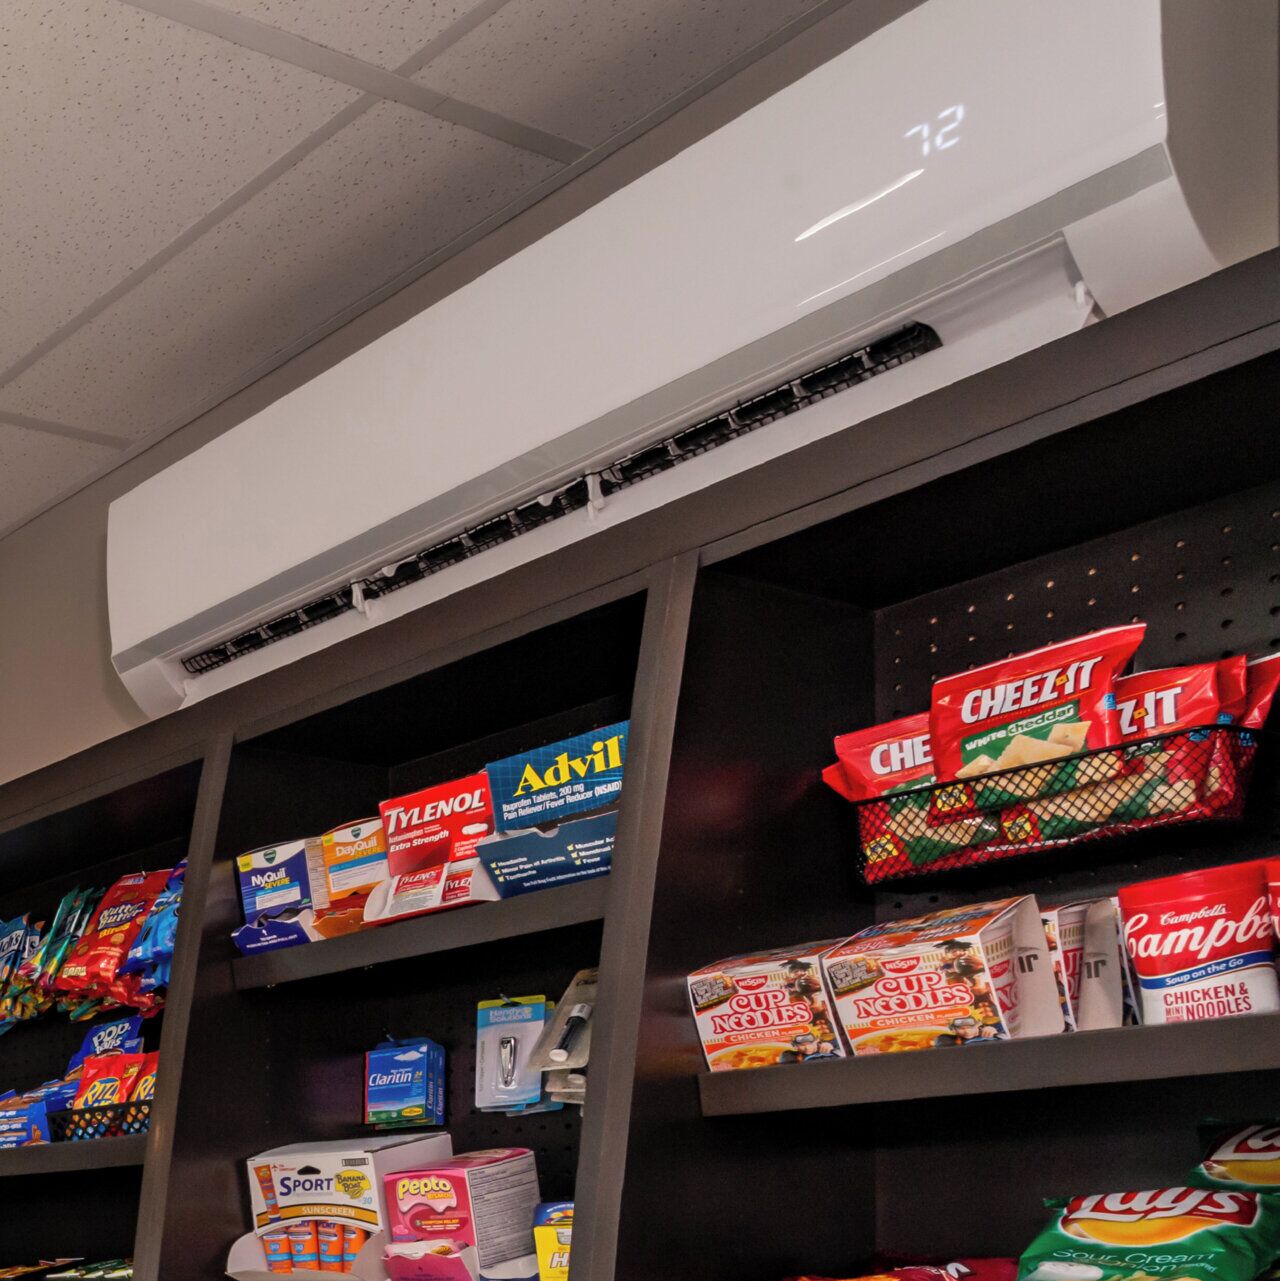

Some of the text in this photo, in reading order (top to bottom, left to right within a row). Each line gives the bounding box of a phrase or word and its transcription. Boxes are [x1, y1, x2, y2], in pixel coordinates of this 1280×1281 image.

[903, 104, 965, 156] 72
[513, 735, 624, 797] Advil
[503, 782, 585, 812] Ibuprofen Tablets, 200 mg
[503, 809, 517, 821] Pain
[566, 790, 593, 805] Reducer
[594, 780, 623, 798] (NSAID)
[384, 789, 486, 835] TYLENOL
[335, 836, 378, 857] DayQuil
[390, 841, 411, 853] Extra
[412, 830, 450, 847] Strength
[251, 867, 286, 887] NyQuil
[264, 877, 290, 889] SEVERE
[885, 959, 918, 970] NISSIN
[1165, 958, 1243, 985] Soup on the Go
[875, 972, 942, 997] CUP
[1164, 982, 1249, 1007] CHICKEN &
[730, 990, 785, 1013] CUP
[854, 984, 975, 1019] NOODLES
[1186, 995, 1252, 1021] NOODLES
[711, 1002, 813, 1034] NOODLES
[877, 1013, 935, 1027] CHICKEN
[730, 1030, 780, 1042] CHICKEN
[369, 1070, 412, 1087] Claritin
[82, 1080, 120, 1105] RITZ
[280, 1176, 334, 1197] SPORT
[398, 1177, 451, 1200] Pepto
[302, 1205, 355, 1217] SUNSCREEN
[1052, 1249, 1215, 1264] Sour Cream
